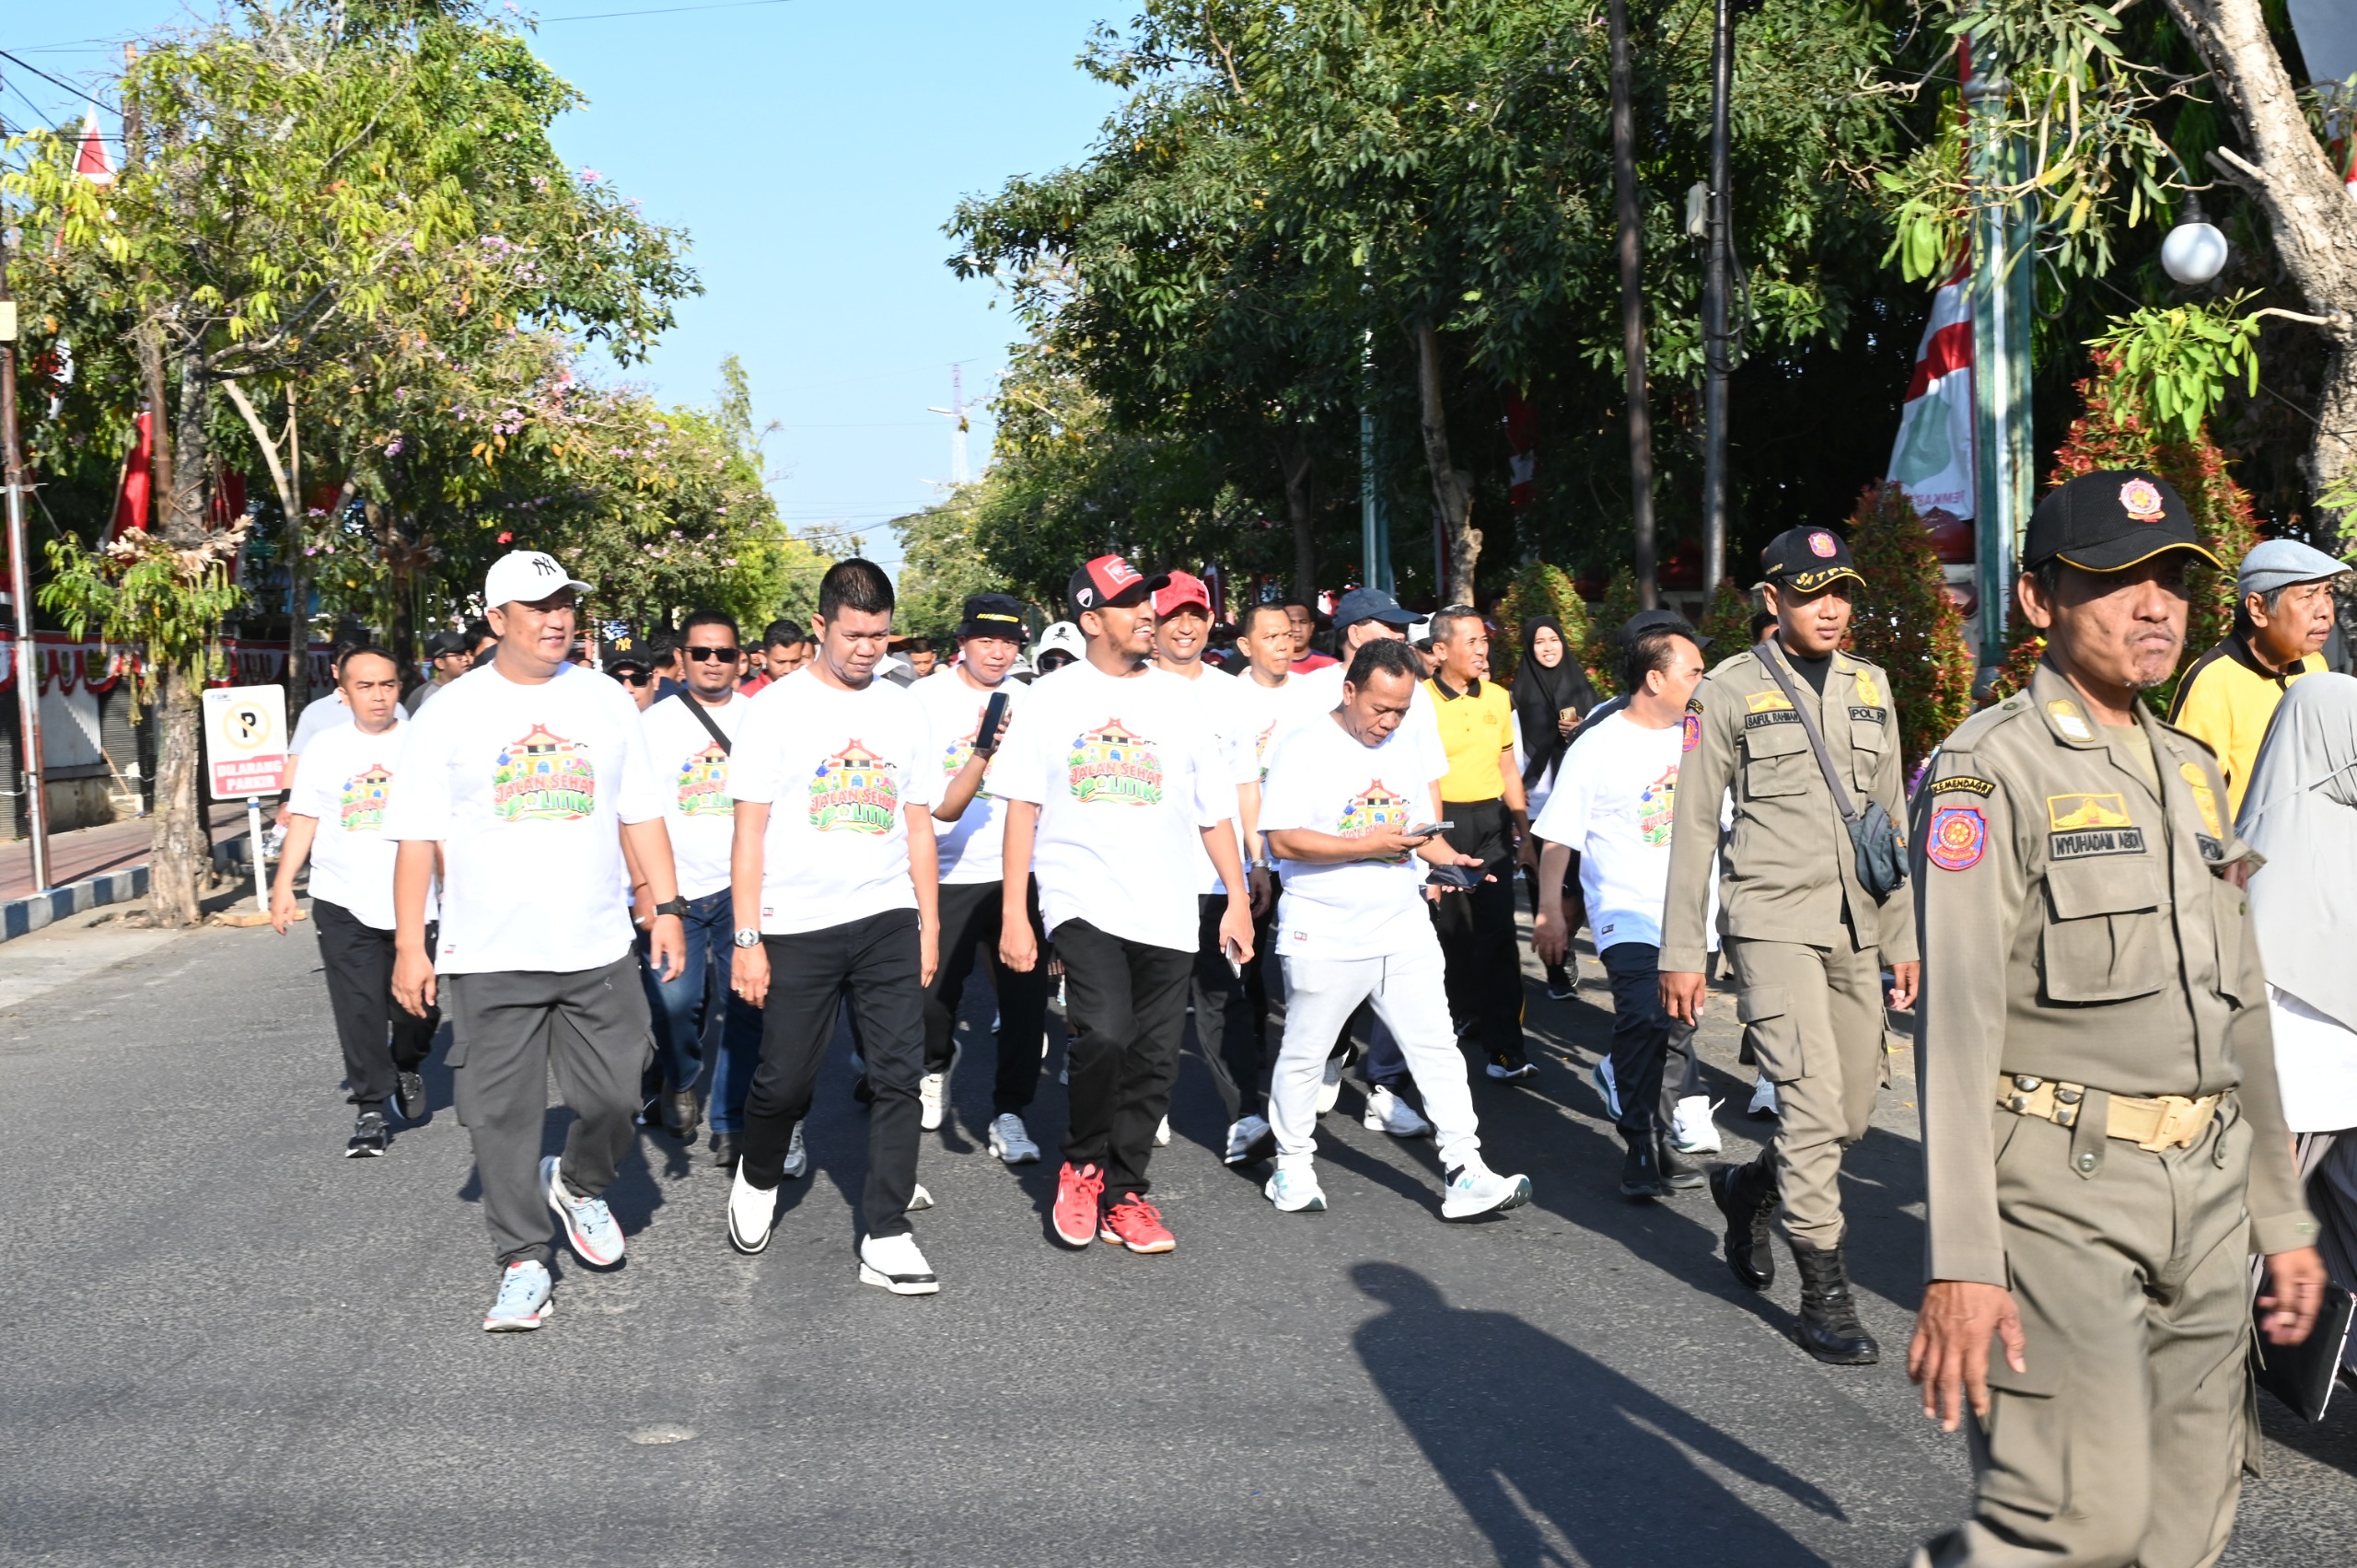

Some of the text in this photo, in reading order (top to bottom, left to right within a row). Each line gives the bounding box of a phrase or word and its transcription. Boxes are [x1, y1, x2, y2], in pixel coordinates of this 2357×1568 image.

[1747, 714, 1771, 726] SAIFUL
[1852, 708, 1875, 719] POL
[216, 760, 284, 779] DILARANG
[226, 774, 276, 792] PARKIR
[1070, 760, 1163, 788] JALAN SEHAT
[493, 772, 596, 805] JALAN SEHAT
[808, 786, 898, 815] JALAN SEHAT
[1079, 774, 1157, 805] POLITIK
[507, 790, 591, 817] POLITIK
